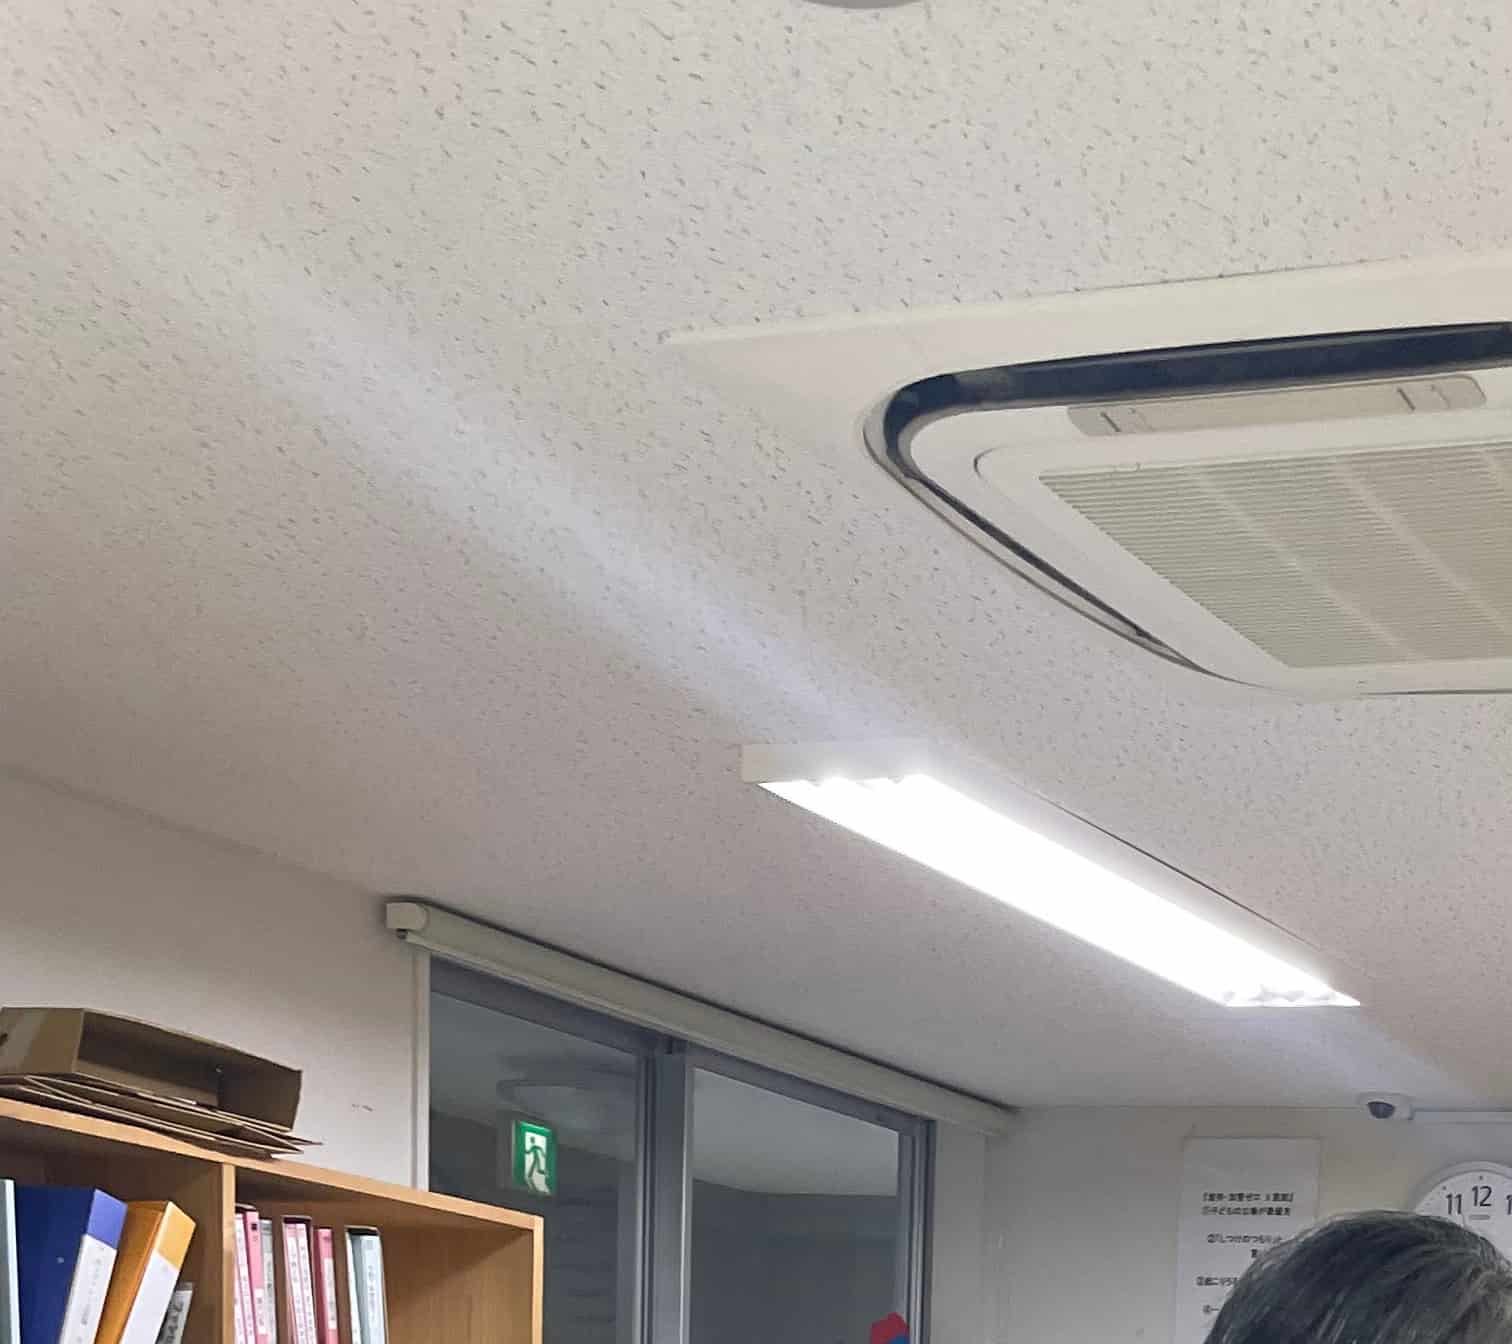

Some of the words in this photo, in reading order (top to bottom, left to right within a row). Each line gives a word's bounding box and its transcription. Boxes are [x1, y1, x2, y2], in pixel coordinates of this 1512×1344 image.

[1446, 1194, 1462, 1214] 11
[1472, 1186, 1492, 1207] 12
[1506, 1194, 1512, 1215] 1
